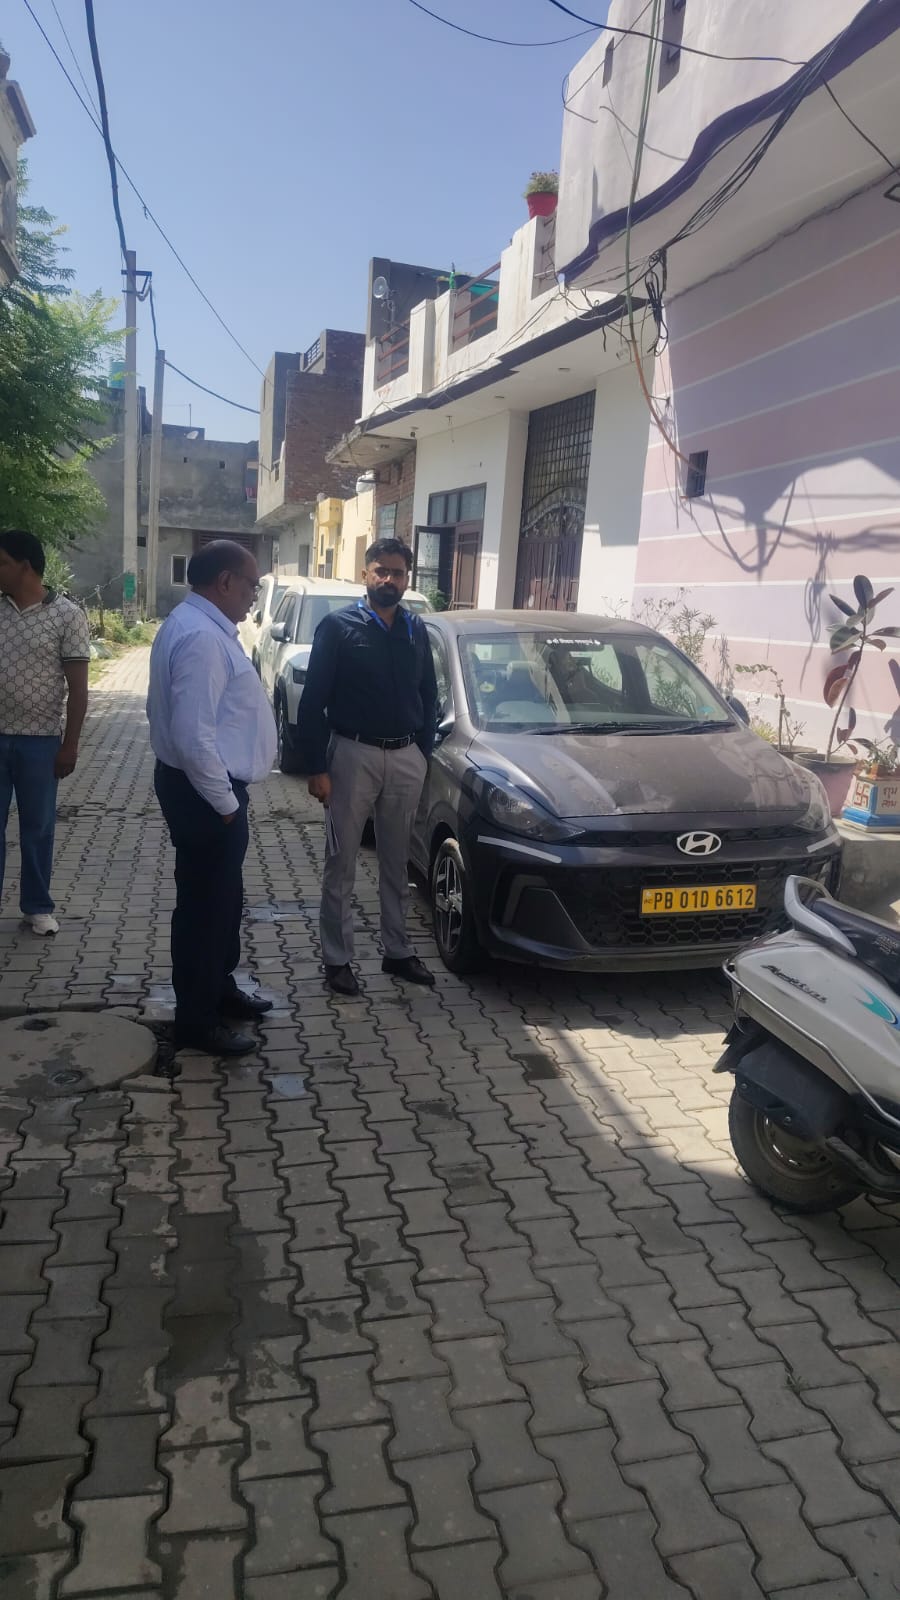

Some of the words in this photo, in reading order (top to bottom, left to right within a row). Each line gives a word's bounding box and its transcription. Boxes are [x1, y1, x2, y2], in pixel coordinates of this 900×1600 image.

[653, 892, 673, 910] PB
[680, 890, 709, 909] 01D
[715, 888, 754, 907] 6612
